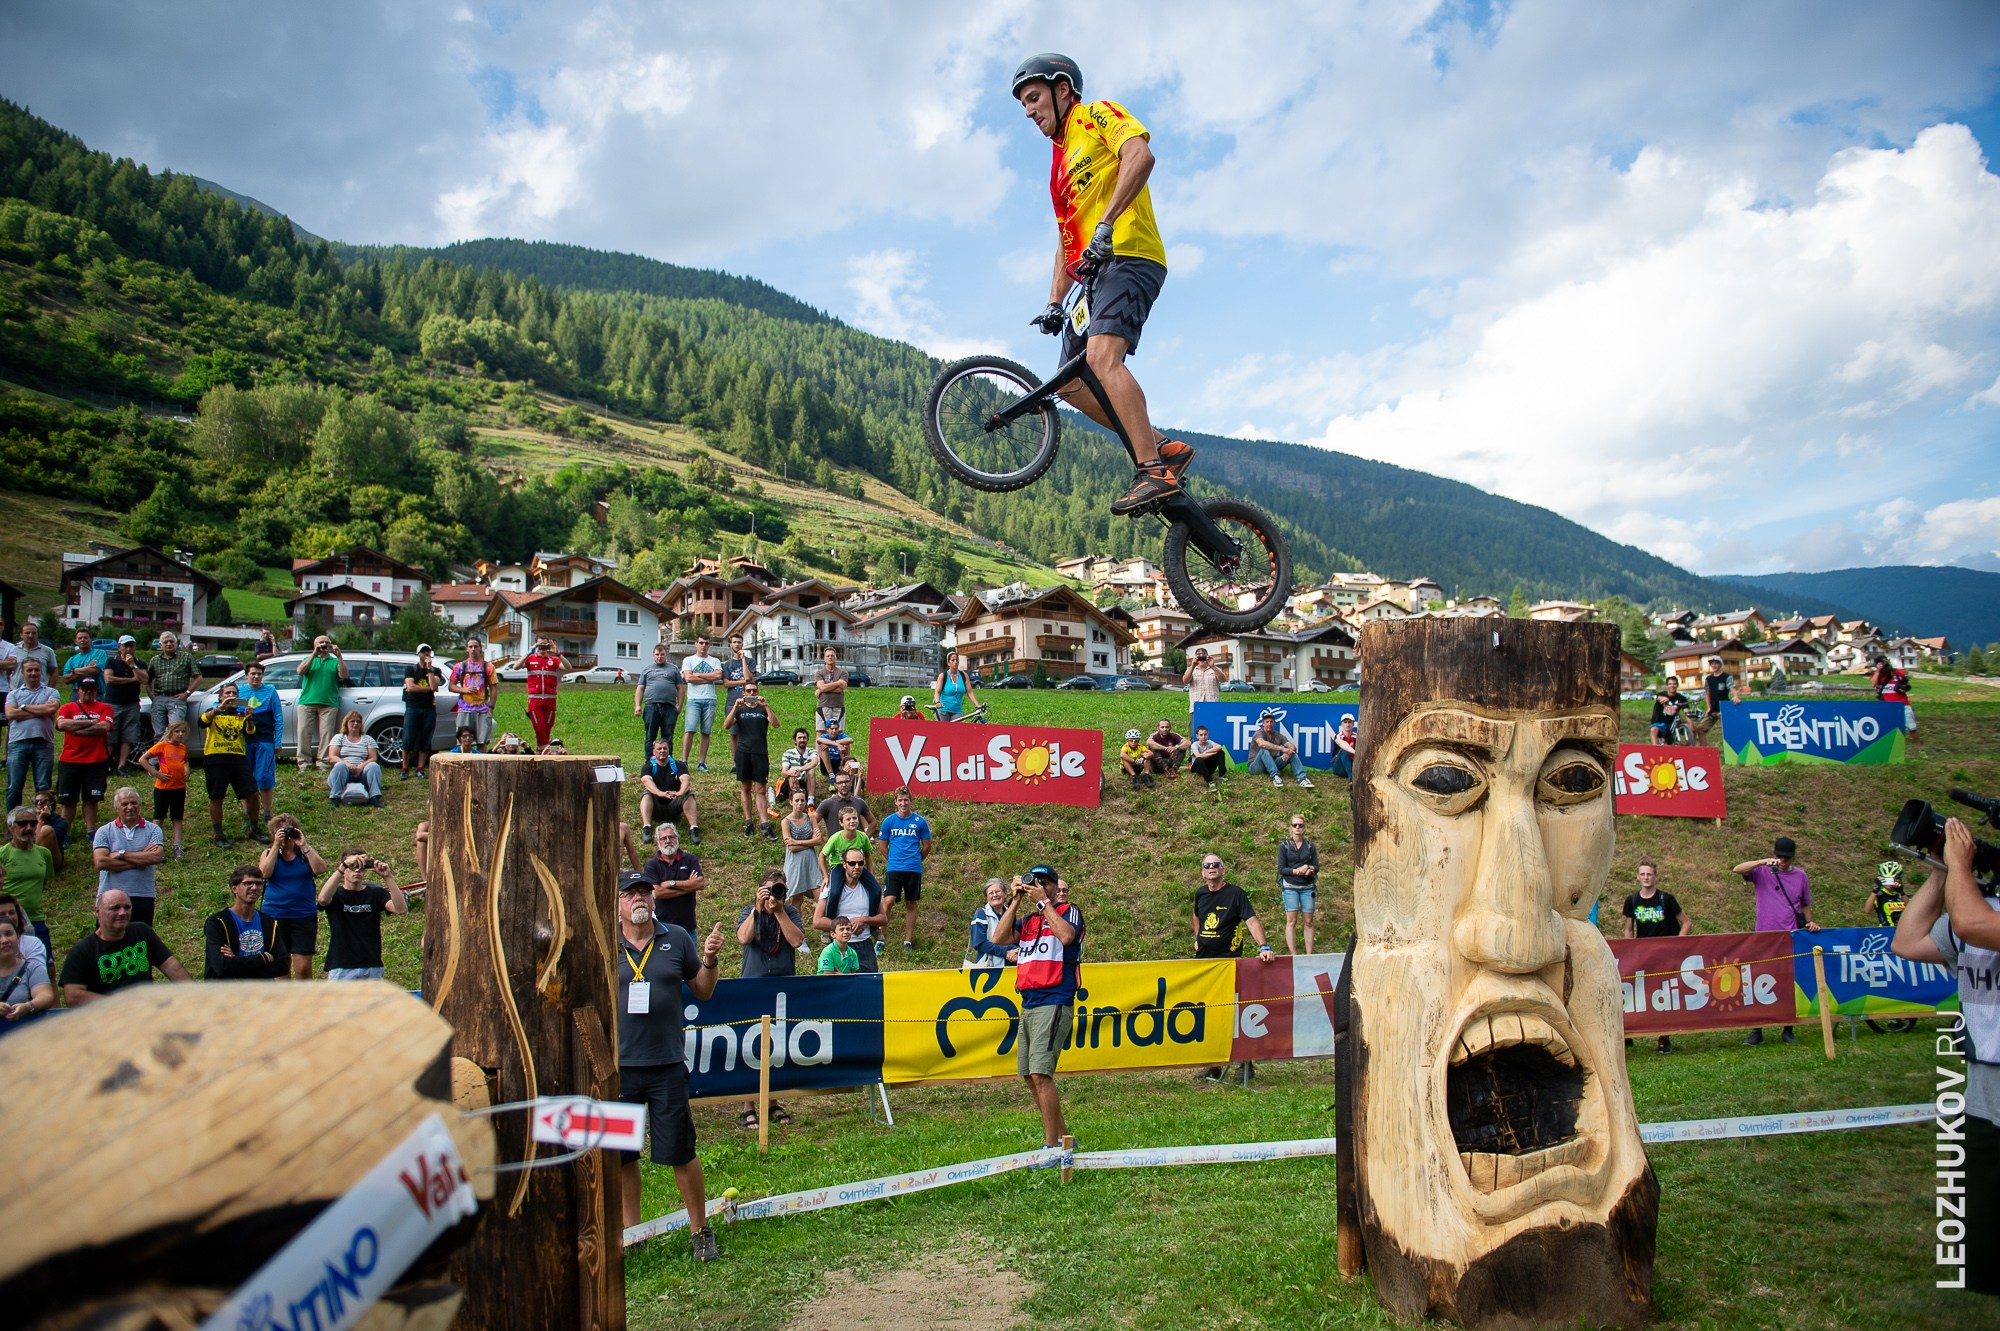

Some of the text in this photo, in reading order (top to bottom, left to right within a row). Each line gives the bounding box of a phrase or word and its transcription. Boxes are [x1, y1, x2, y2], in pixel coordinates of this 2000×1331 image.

[884, 735, 1086, 786] Val di Sole
[1624, 752, 1710, 799] Sole
[890, 828, 917, 837] ITALIA
[1614, 955, 1778, 1013] al di Sole
